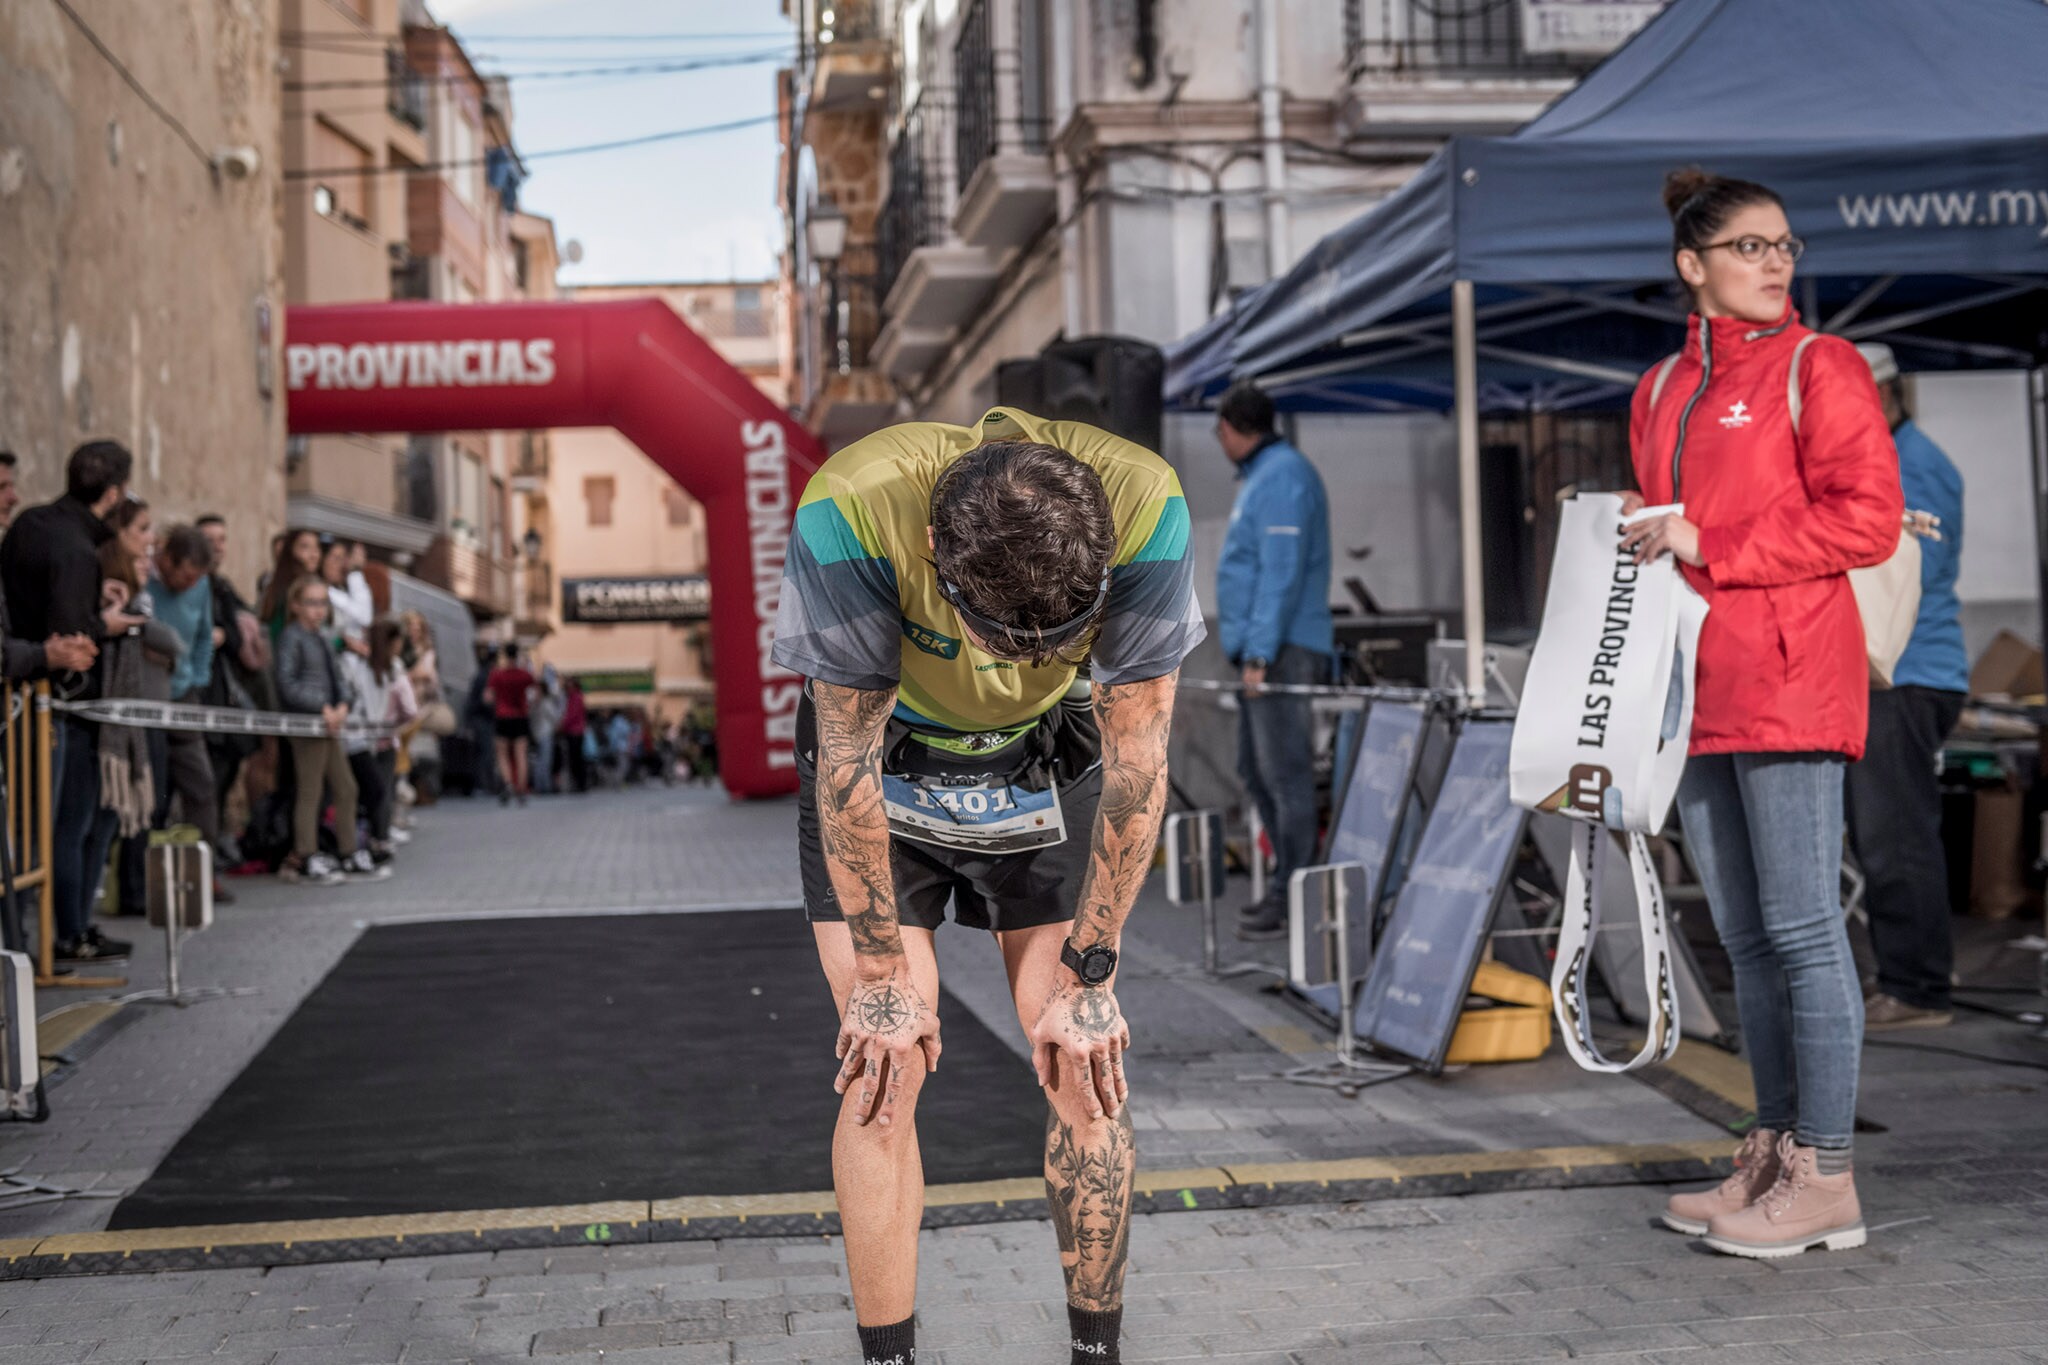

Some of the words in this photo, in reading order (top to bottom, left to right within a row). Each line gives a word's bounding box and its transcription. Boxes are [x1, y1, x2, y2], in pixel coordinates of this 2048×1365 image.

[287, 338, 557, 391] PROVINCIAS
[911, 627, 949, 655] 15K
[1577, 694, 1612, 749] LAS
[944, 778, 978, 786] TRAIL
[912, 787, 1016, 814] 1401
[953, 811, 980, 822] arlitos
